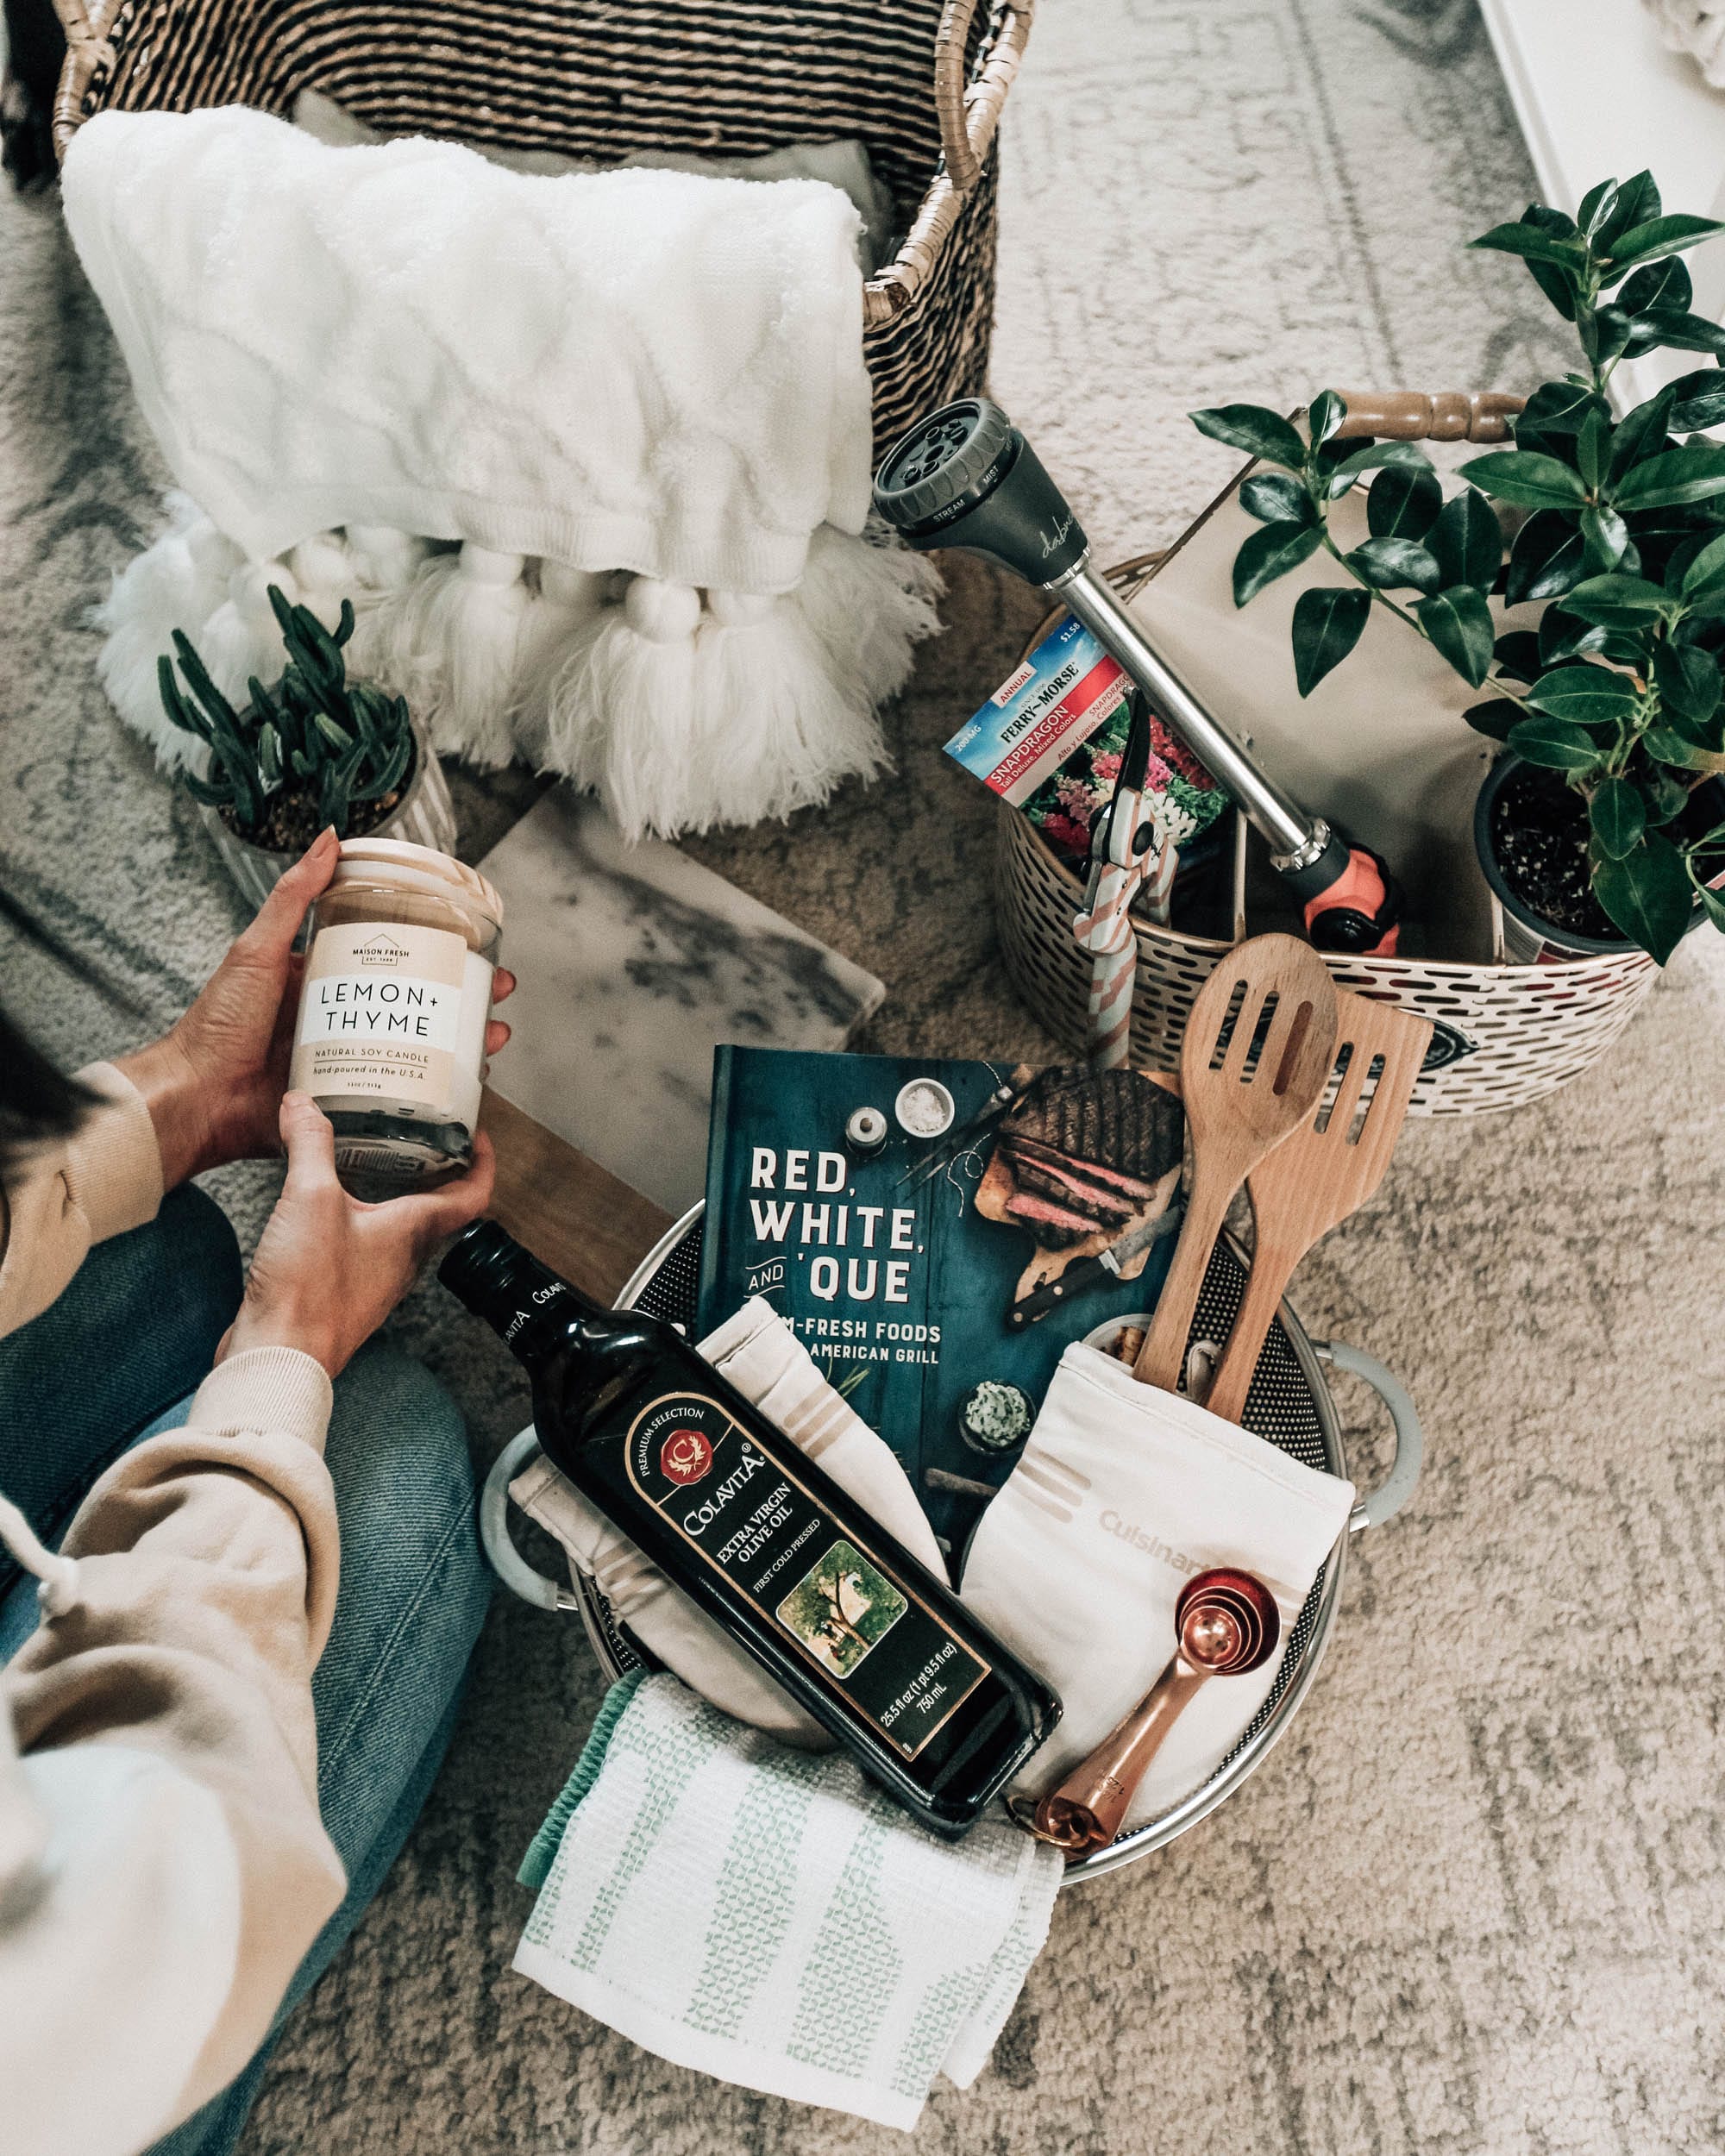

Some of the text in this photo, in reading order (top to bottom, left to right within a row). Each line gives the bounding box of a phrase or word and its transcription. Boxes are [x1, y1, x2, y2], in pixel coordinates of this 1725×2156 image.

[983, 466, 1000, 485] MIST
[933, 498, 966, 523] STREAM
[1060, 622, 1081, 642] $1.58
[1000, 672, 1032, 703] ANNUAL
[1089, 674, 1130, 716] SNAPDRAGO
[991, 705, 1069, 783] SNAPDRAGON
[1058, 747, 1071, 761] Alto
[1097, 697, 1120, 719] Colores
[1000, 714, 1076, 788] Tall Deluxe, Mixed Colors
[326, 1011, 430, 1037] THYME
[315, 1048, 355, 1057] NATURAL
[386, 1050, 429, 1063] CANDLE
[381, 1067, 396, 1075] the
[750, 1147, 855, 1197] RED,
[749, 1199, 925, 1254] WHITE,
[532, 1282, 567, 1304] COLAVIT
[748, 1264, 784, 1291] AND
[797, 1252, 912, 1303] 'QUE
[781, 1316, 941, 1344] M-FRESH FOODS
[810, 1343, 939, 1364] AMERICAN GRILL
[638, 1407, 705, 1478] PREMIUM SELECTION
[716, 1482, 791, 1564] EXTRA VIRGIN
[738, 1504, 793, 1562] OLIVE OIL
[1099, 1509, 1210, 1575] Cuisinar
[753, 1519, 820, 1593] FIRST COLD PRESSED
[881, 1642, 957, 1727] 25.5 fl oz (1 pt 9.5 fl oz)
[916, 1682, 947, 1714] 750 mL
